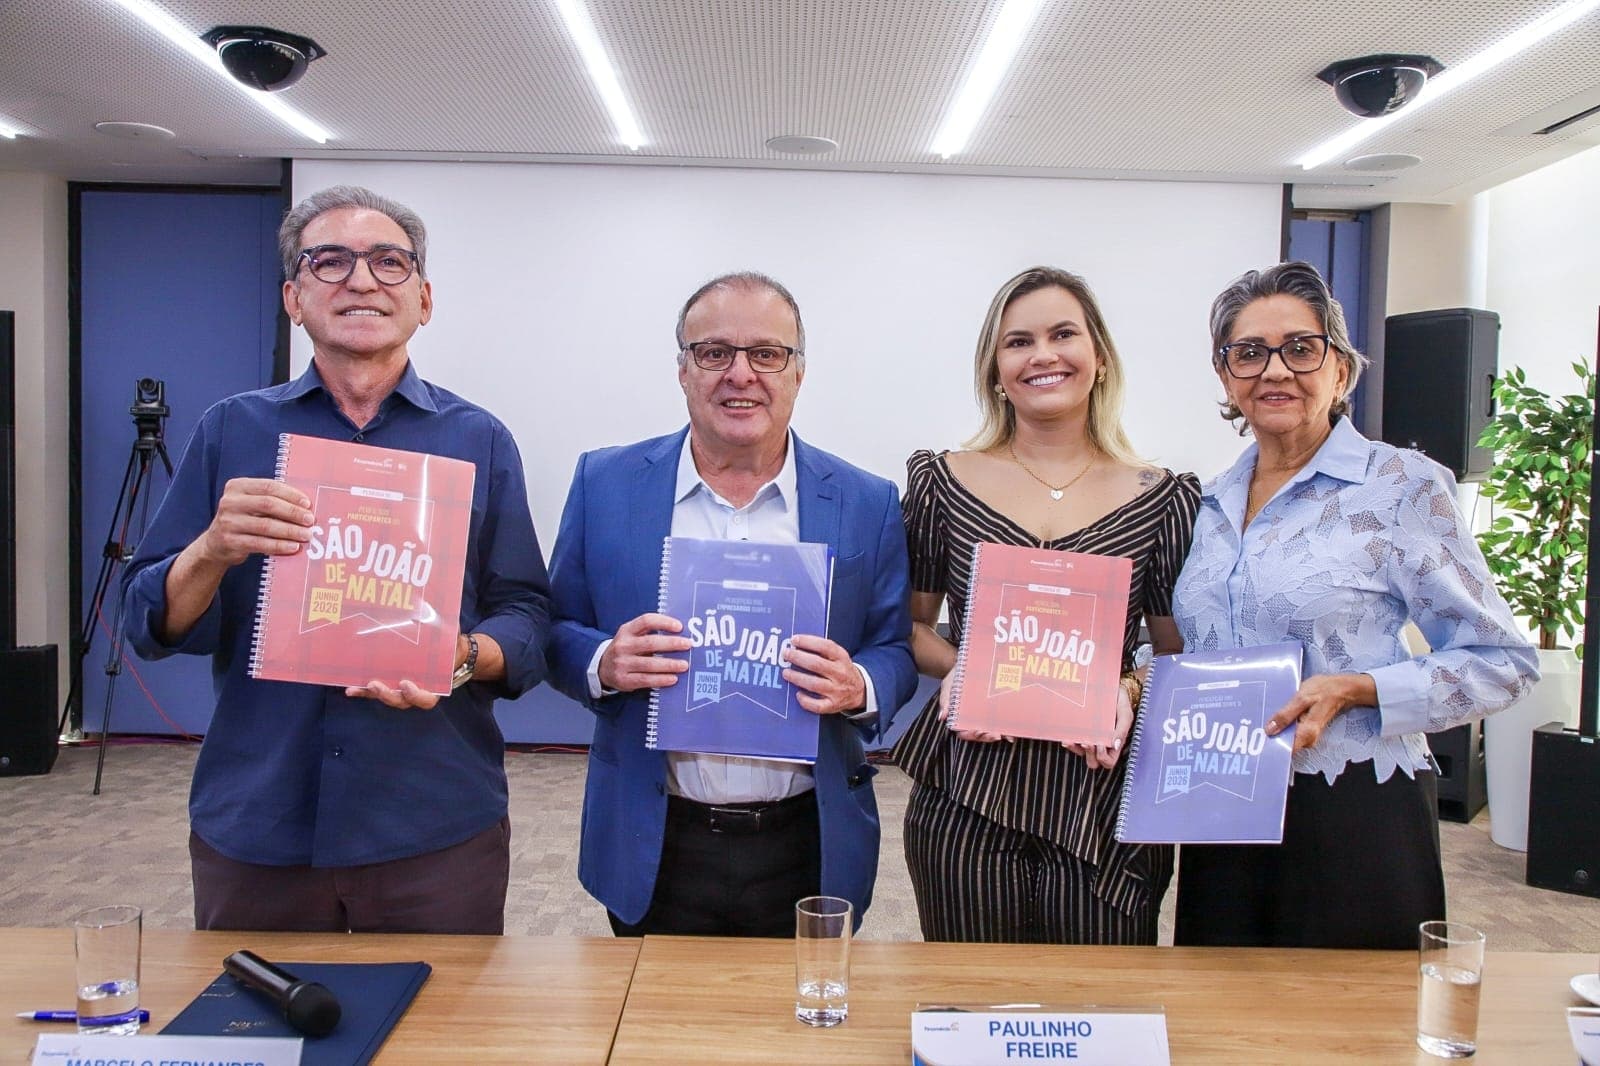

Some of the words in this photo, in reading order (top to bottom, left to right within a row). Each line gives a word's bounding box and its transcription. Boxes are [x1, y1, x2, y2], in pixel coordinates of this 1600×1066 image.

[306, 517, 363, 561] SÃO
[358, 540, 433, 588] JOÃO
[325, 563, 347, 584] DE
[314, 591, 339, 602] JUNHO
[346, 574, 415, 611] NATAL
[312, 600, 339, 614] 2026
[688, 609, 736, 648] SÃO
[994, 609, 1039, 644] SÃO
[1034, 628, 1096, 667] JOÃO
[705, 649, 724, 668] DE
[1008, 645, 1026, 662] DE
[723, 659, 783, 690] NATAL
[1024, 654, 1081, 683] NATAL
[697, 673, 719, 684] JUNHO
[696, 683, 719, 695] 2026
[1162, 709, 1207, 744] SÃO
[1203, 718, 1268, 756] JOÃO
[1177, 743, 1195, 761] DE
[1169, 767, 1188, 776] JUNHO
[1193, 751, 1251, 776] NATAL
[1166, 775, 1189, 787] 2026
[988, 1021, 1092, 1037] PAULINHO
[1006, 1042, 1078, 1058] FREIRE
